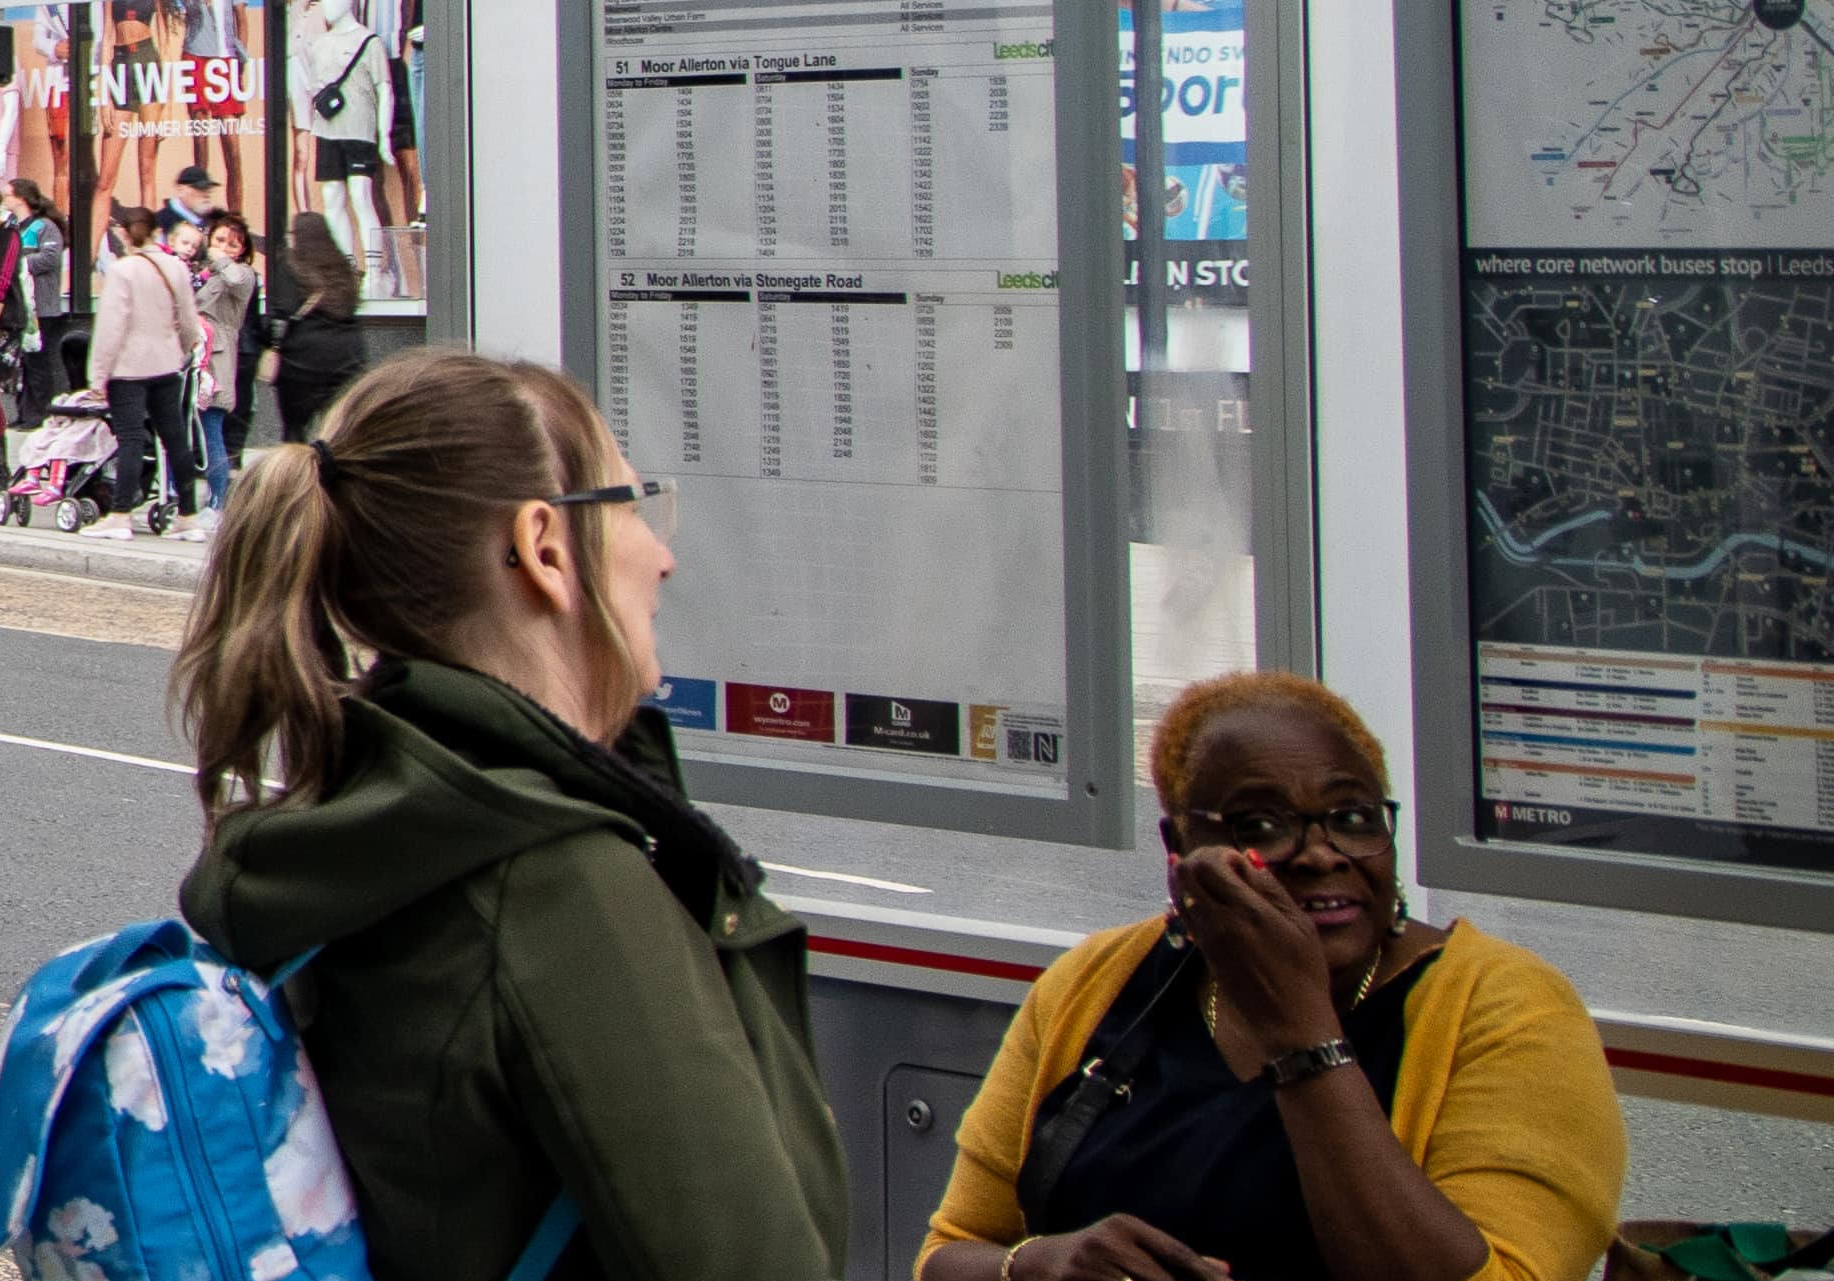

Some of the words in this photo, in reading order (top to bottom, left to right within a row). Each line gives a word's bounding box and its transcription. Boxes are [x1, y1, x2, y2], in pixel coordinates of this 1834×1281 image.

[615, 59, 630, 75] 51
[641, 58, 674, 74] Moor
[679, 54, 727, 72] Allerton
[729, 55, 750, 70] via
[753, 53, 800, 72] Tongue
[804, 52, 837, 67] Lane
[134, 59, 198, 105] WE
[204, 57, 265, 104] SU
[118, 119, 182, 137] SUMMER
[184, 117, 266, 137] ESSENTIALS
[1476, 254, 1531, 275] where
[1536, 255, 1576, 275] core
[1580, 255, 1653, 276] network
[1660, 255, 1715, 276] buses
[1720, 256, 1763, 280] stop
[1778, 255, 1834, 277] Leeds
[619, 272, 636, 287] 52
[646, 272, 679, 287] Moor
[681, 271, 731, 288] Allerton
[732, 272, 753, 288] via
[755, 272, 823, 291] Stonegate
[826, 273, 863, 289] Road
[1512, 806, 1572, 826] METRO
